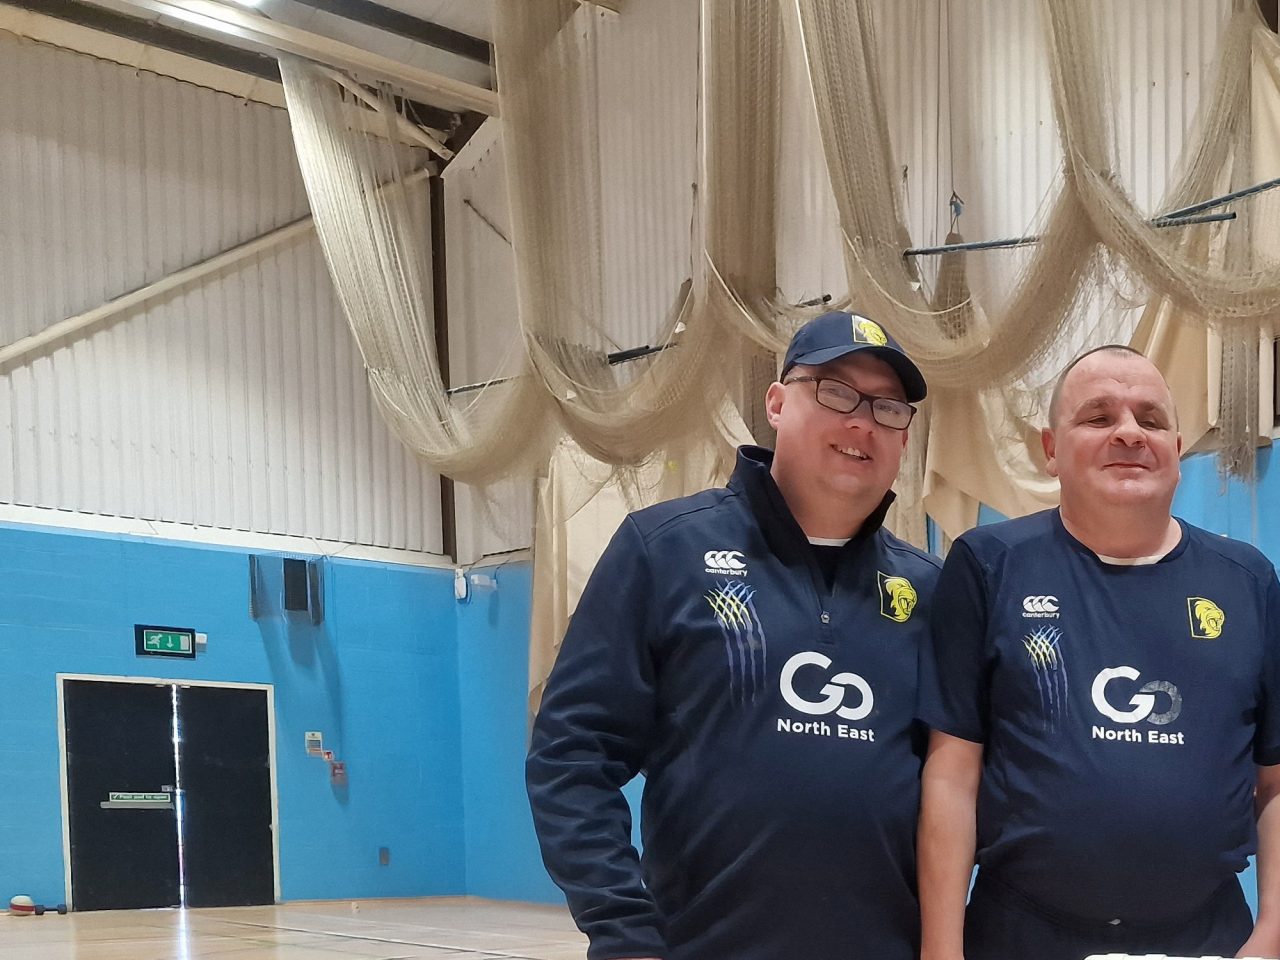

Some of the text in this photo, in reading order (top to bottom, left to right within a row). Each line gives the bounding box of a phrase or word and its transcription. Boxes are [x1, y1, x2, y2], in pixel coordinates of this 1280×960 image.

[704, 568, 748, 577] canterbury
[1022, 612, 1060, 620] canterbury
[777, 718, 875, 742] North East
[1092, 726, 1185, 745] North East
